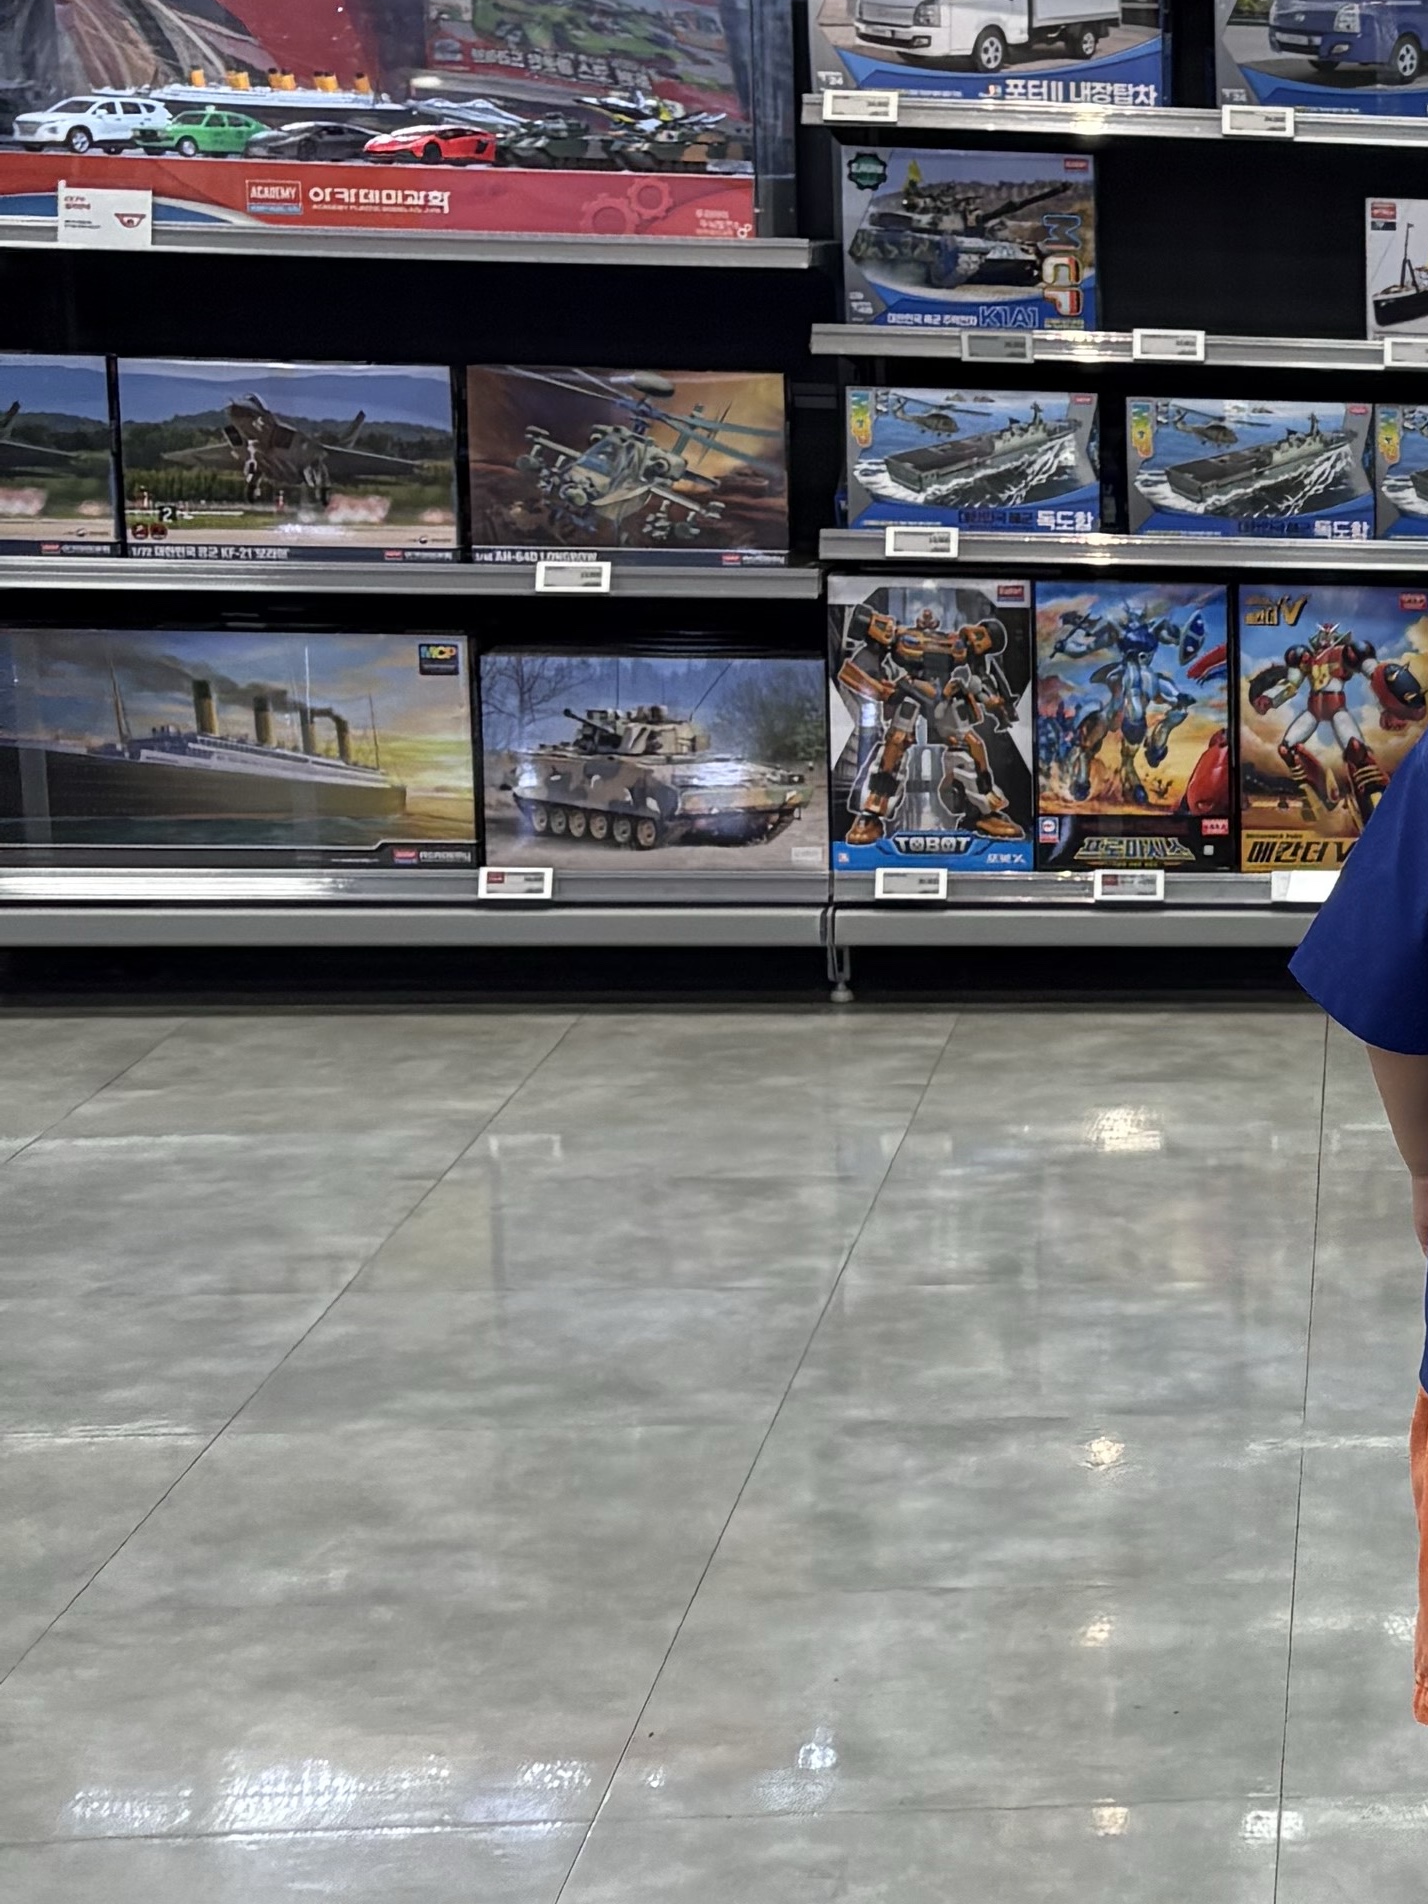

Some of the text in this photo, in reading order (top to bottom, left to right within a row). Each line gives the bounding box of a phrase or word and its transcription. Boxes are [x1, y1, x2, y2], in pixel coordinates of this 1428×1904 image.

[250, 185, 297, 200] ACADEMY
[308, 186, 451, 214] 아카데미과학
[1036, 510, 1095, 532] 독도함
[1313, 519, 1371, 541] 독도함
[894, 834, 973, 854] TOBOT
